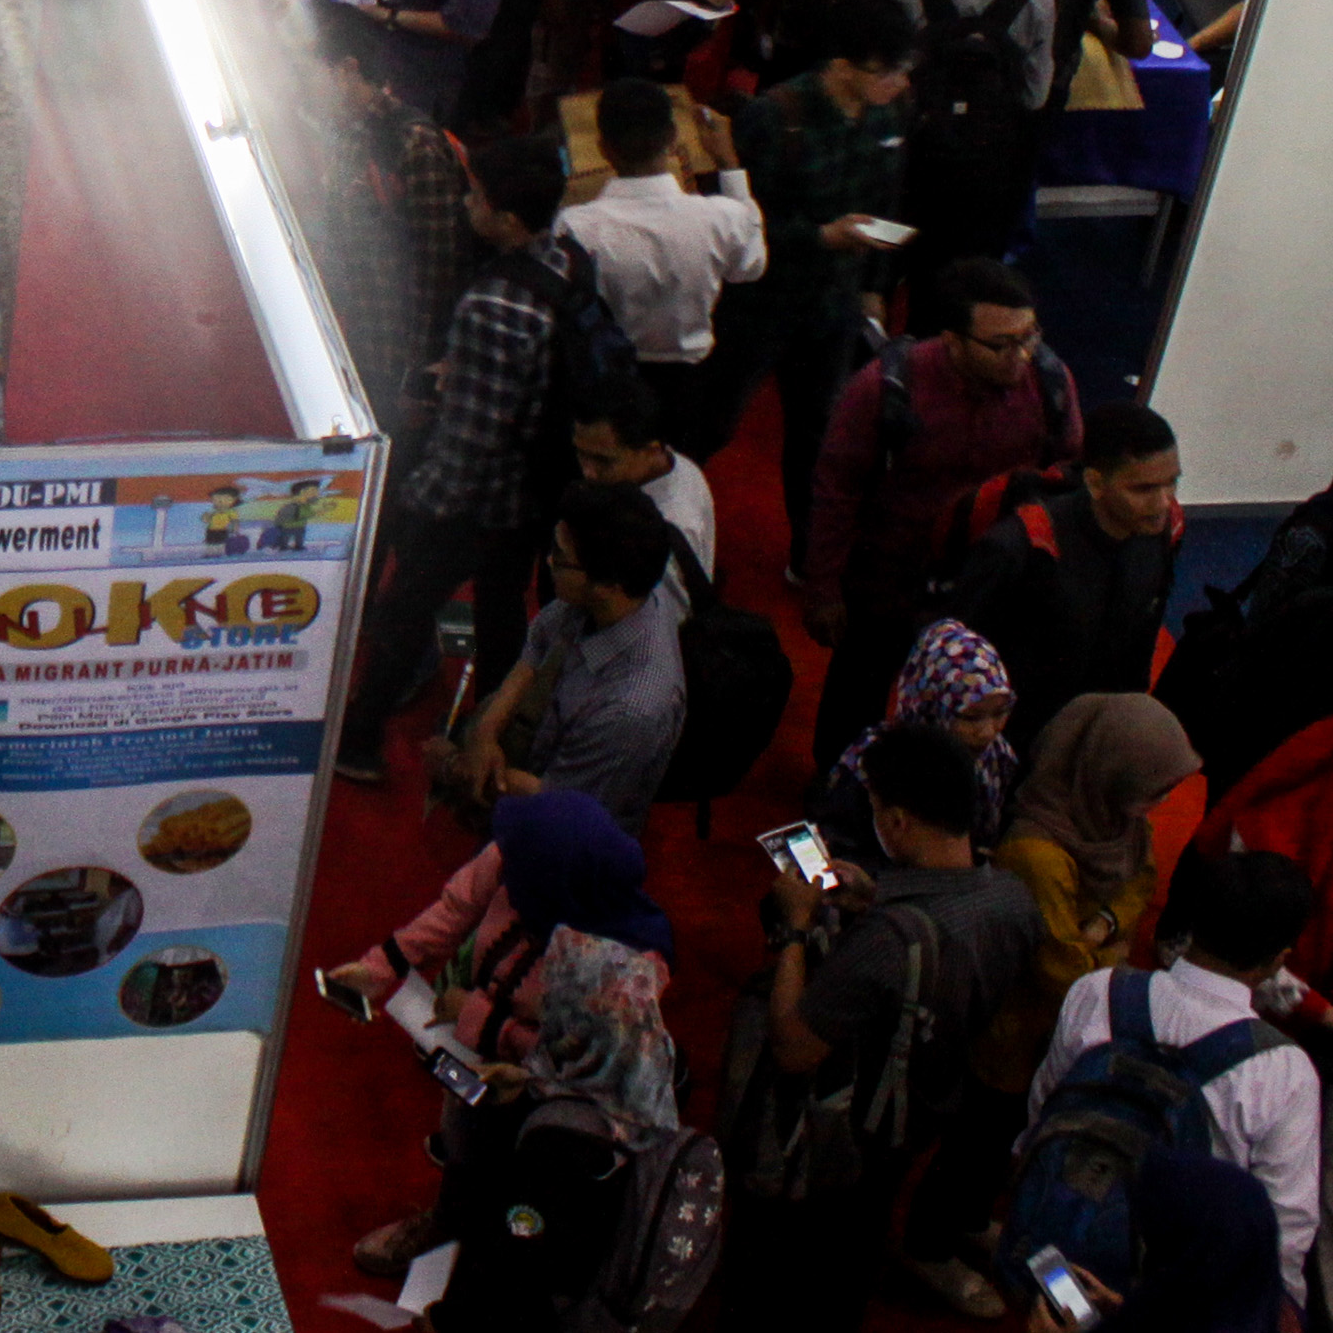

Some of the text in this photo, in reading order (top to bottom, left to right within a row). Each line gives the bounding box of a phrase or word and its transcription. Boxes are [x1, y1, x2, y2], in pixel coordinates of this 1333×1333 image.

[180, 622, 302, 650] STORE
[15, 660, 124, 682] MIGRANT
[132, 651, 295, 677] PURNA-JATIM
[19, 719, 109, 732] Download
[135, 714, 199, 727] Google
[202, 711, 241, 723] Play
[245, 708, 294, 718] Store
[110, 730, 195, 745] Provinsi
